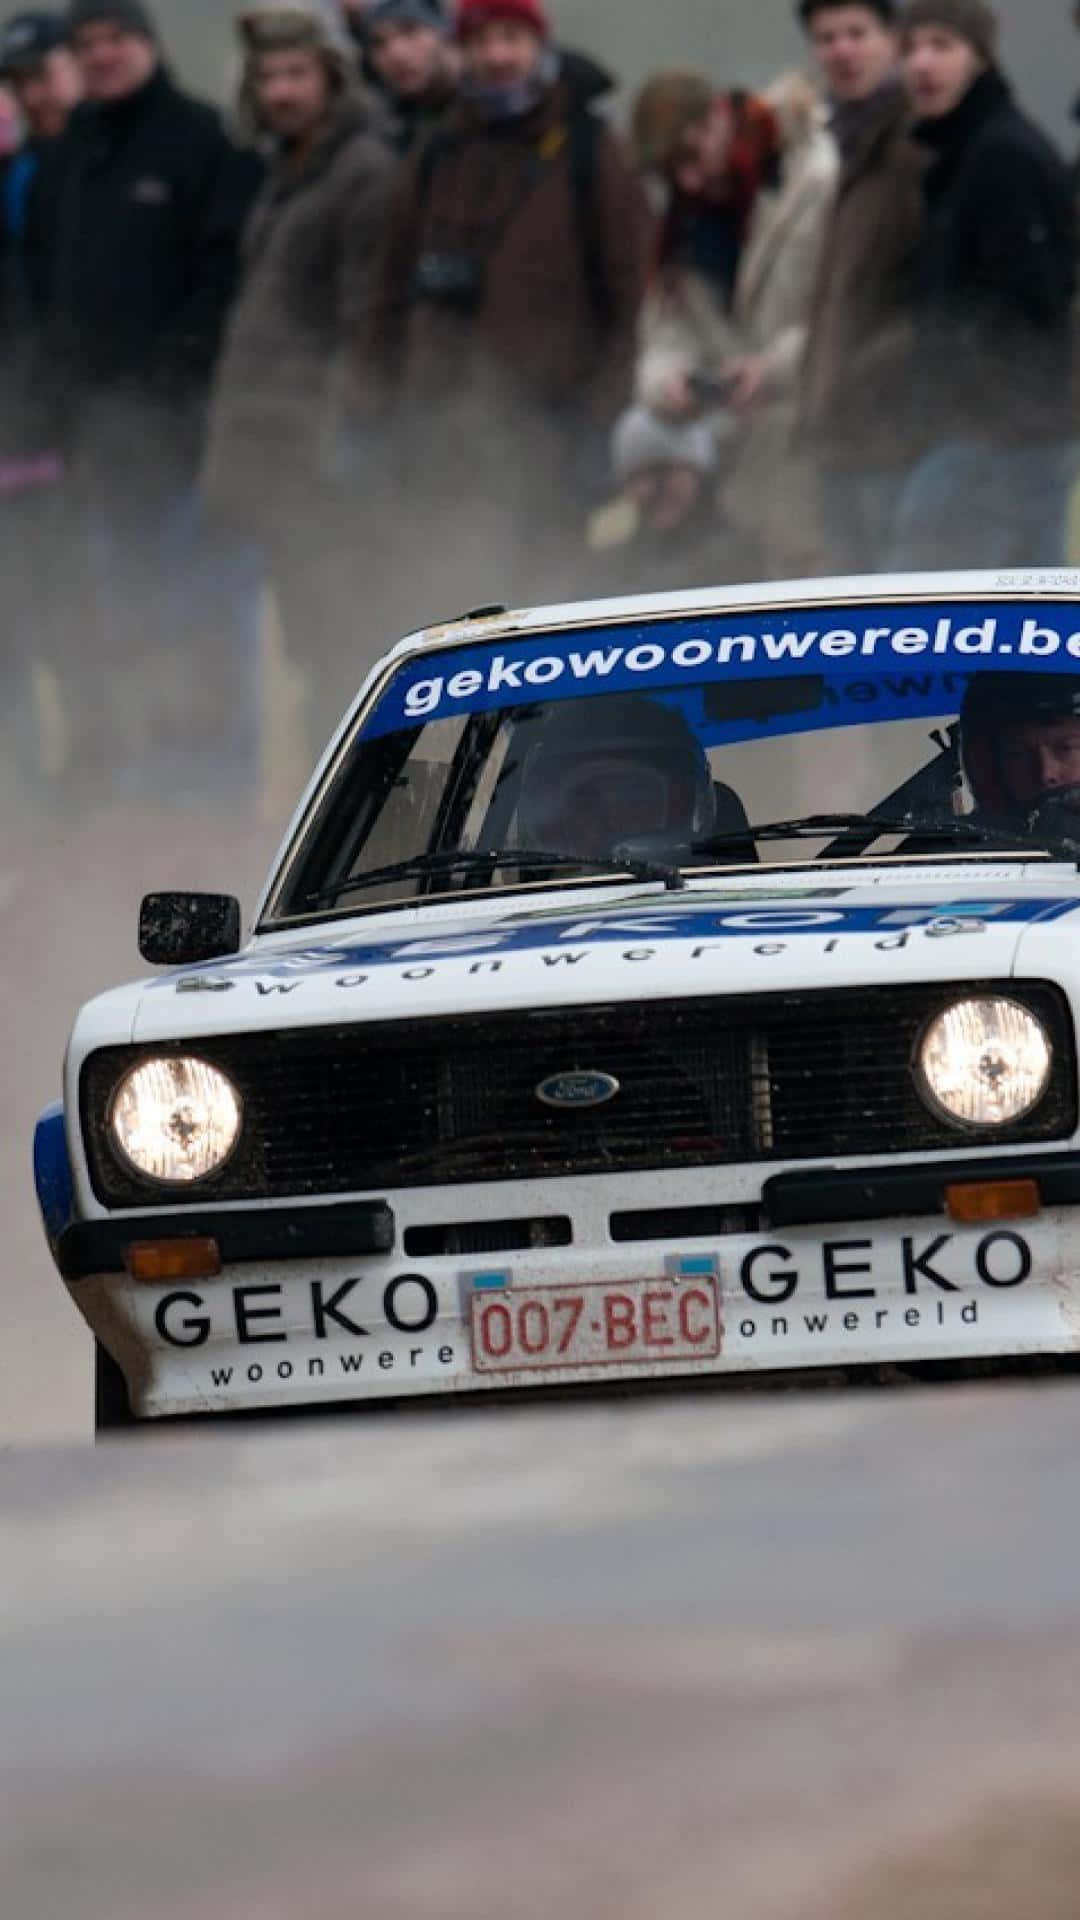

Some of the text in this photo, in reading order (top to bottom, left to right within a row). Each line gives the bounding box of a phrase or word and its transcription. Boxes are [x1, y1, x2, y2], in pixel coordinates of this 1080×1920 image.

[255, 932, 910, 996] woonwereld
[740, 1230, 1032, 1304] GEKO
[155, 1273, 438, 1348] GEKO
[721, 1301, 978, 1338] onwereld
